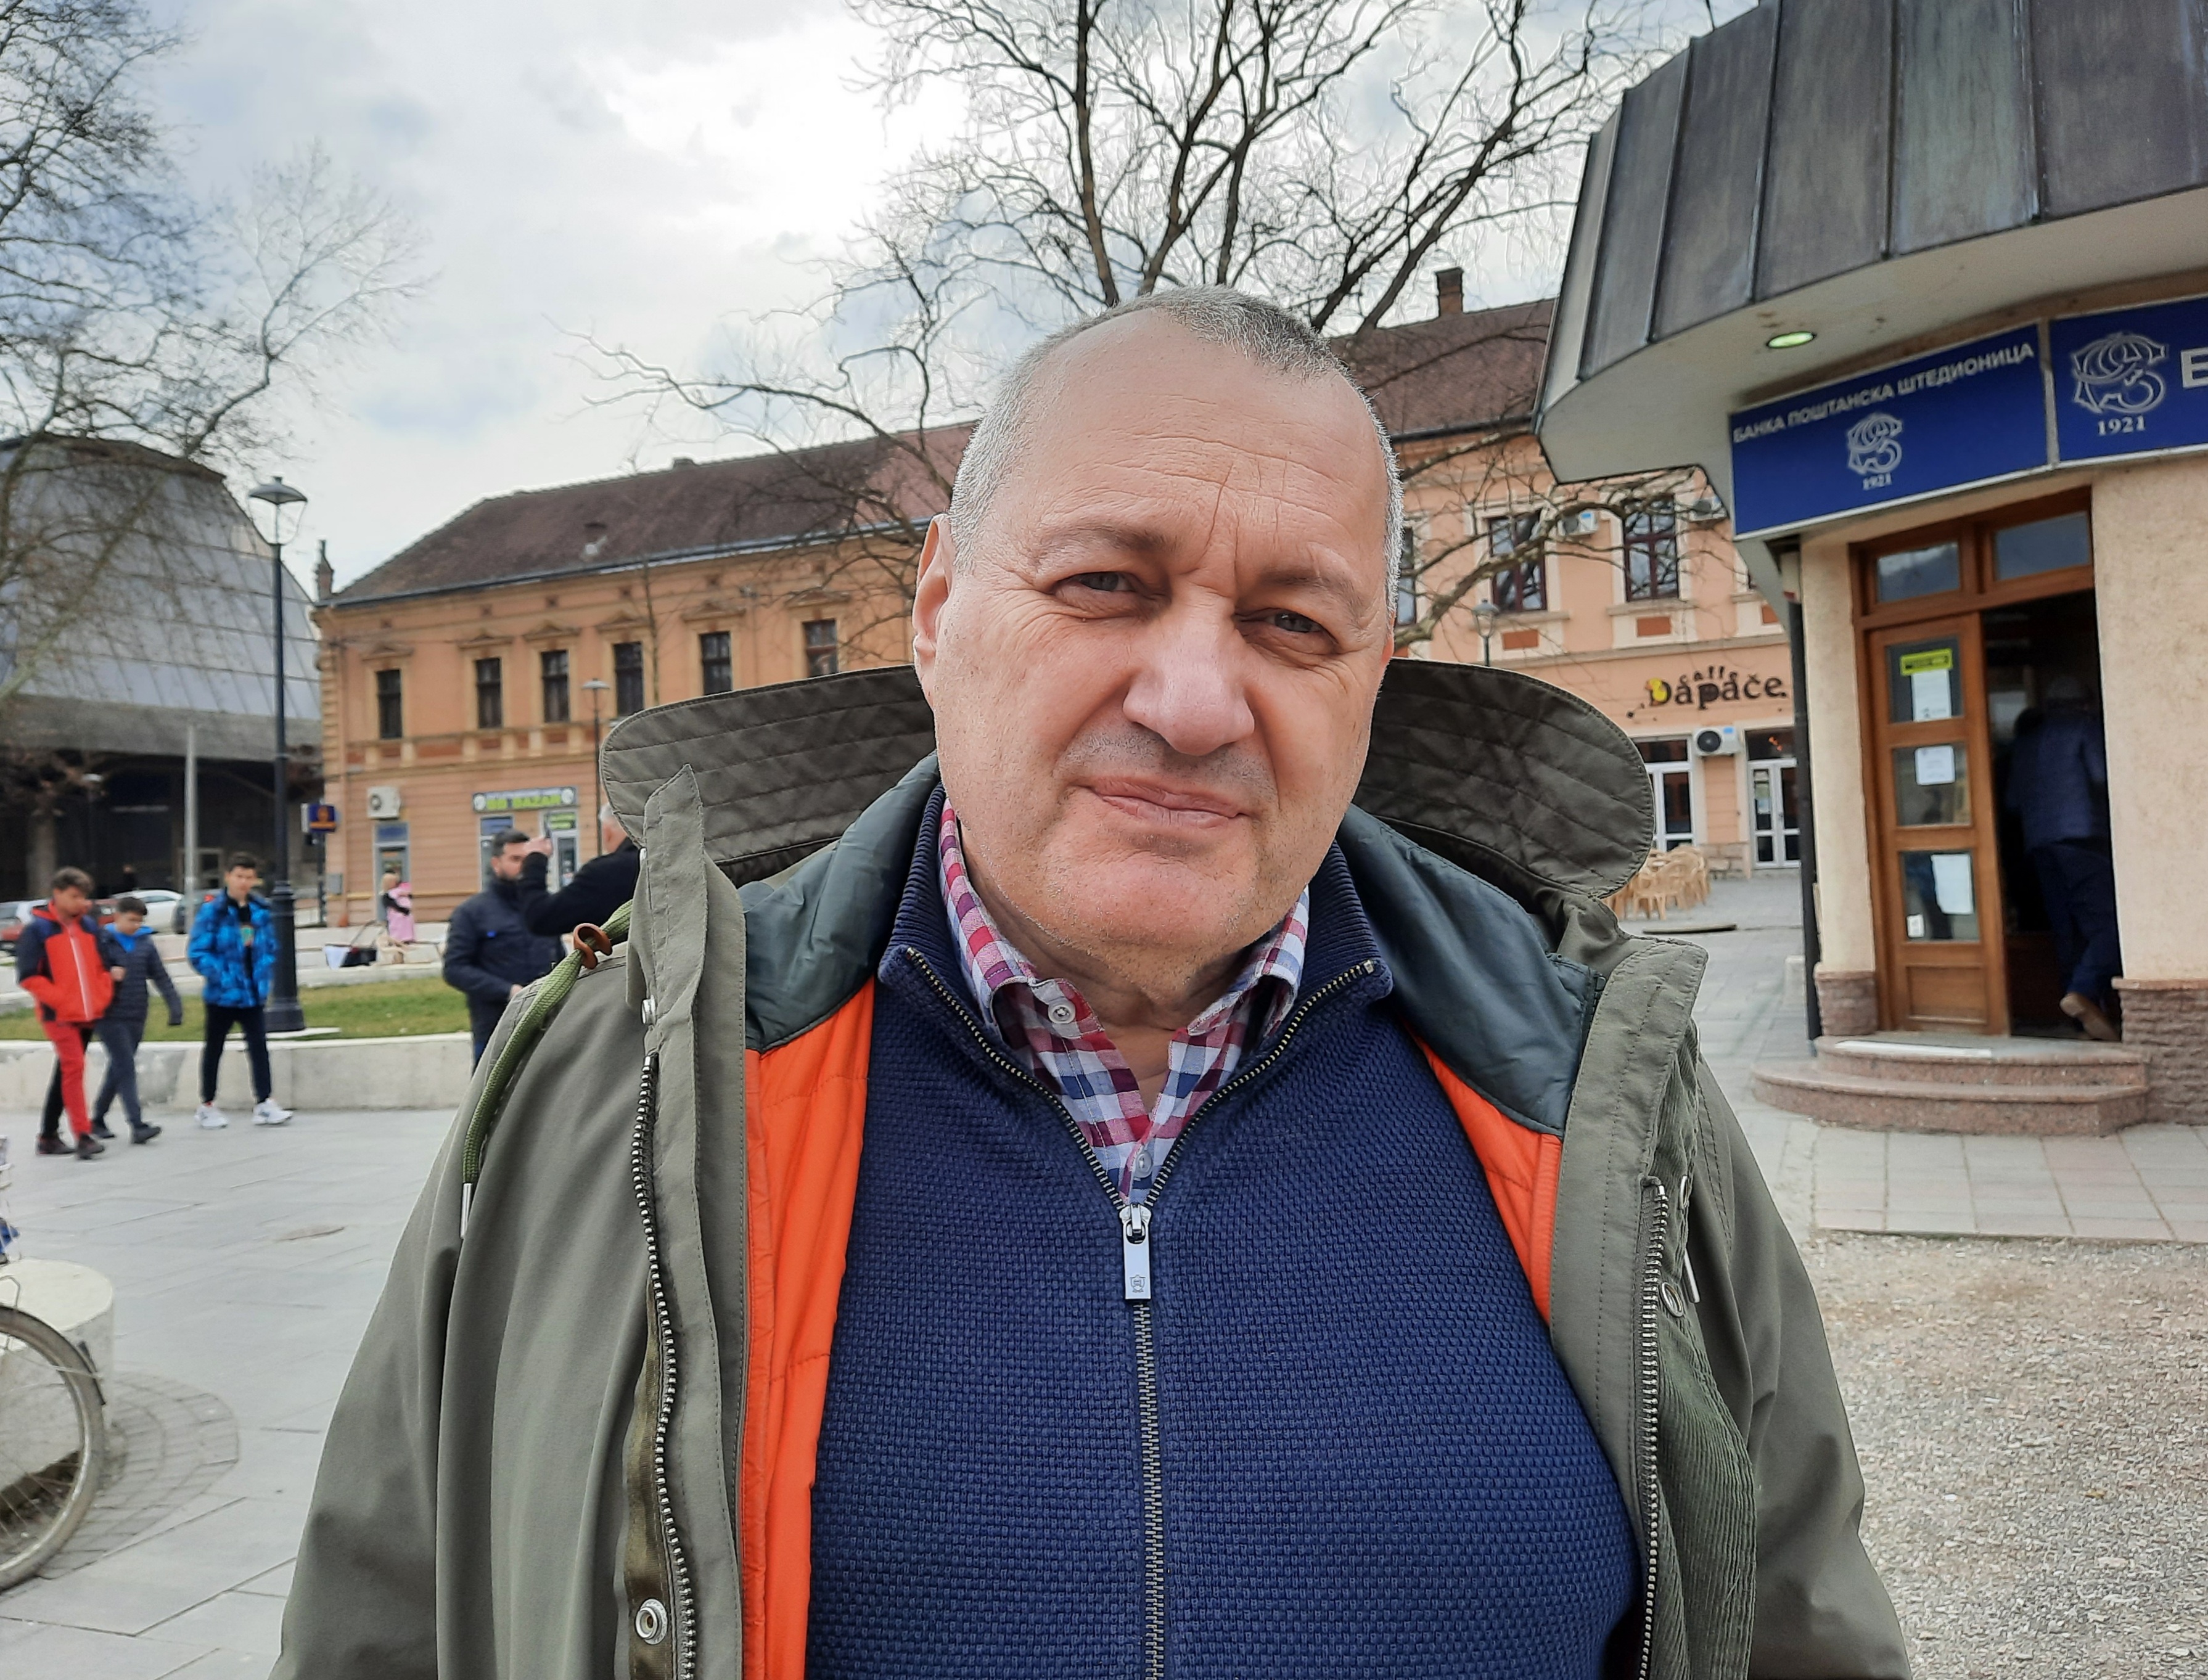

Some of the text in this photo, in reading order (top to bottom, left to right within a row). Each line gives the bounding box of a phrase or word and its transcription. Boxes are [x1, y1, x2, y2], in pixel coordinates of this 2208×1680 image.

[1733, 342, 2034, 443] БАНКА ПОШТАНСКА ШТЕДИОНИЦА
[2098, 416, 2146, 436] 1921
[1863, 472, 1892, 490] 1921
